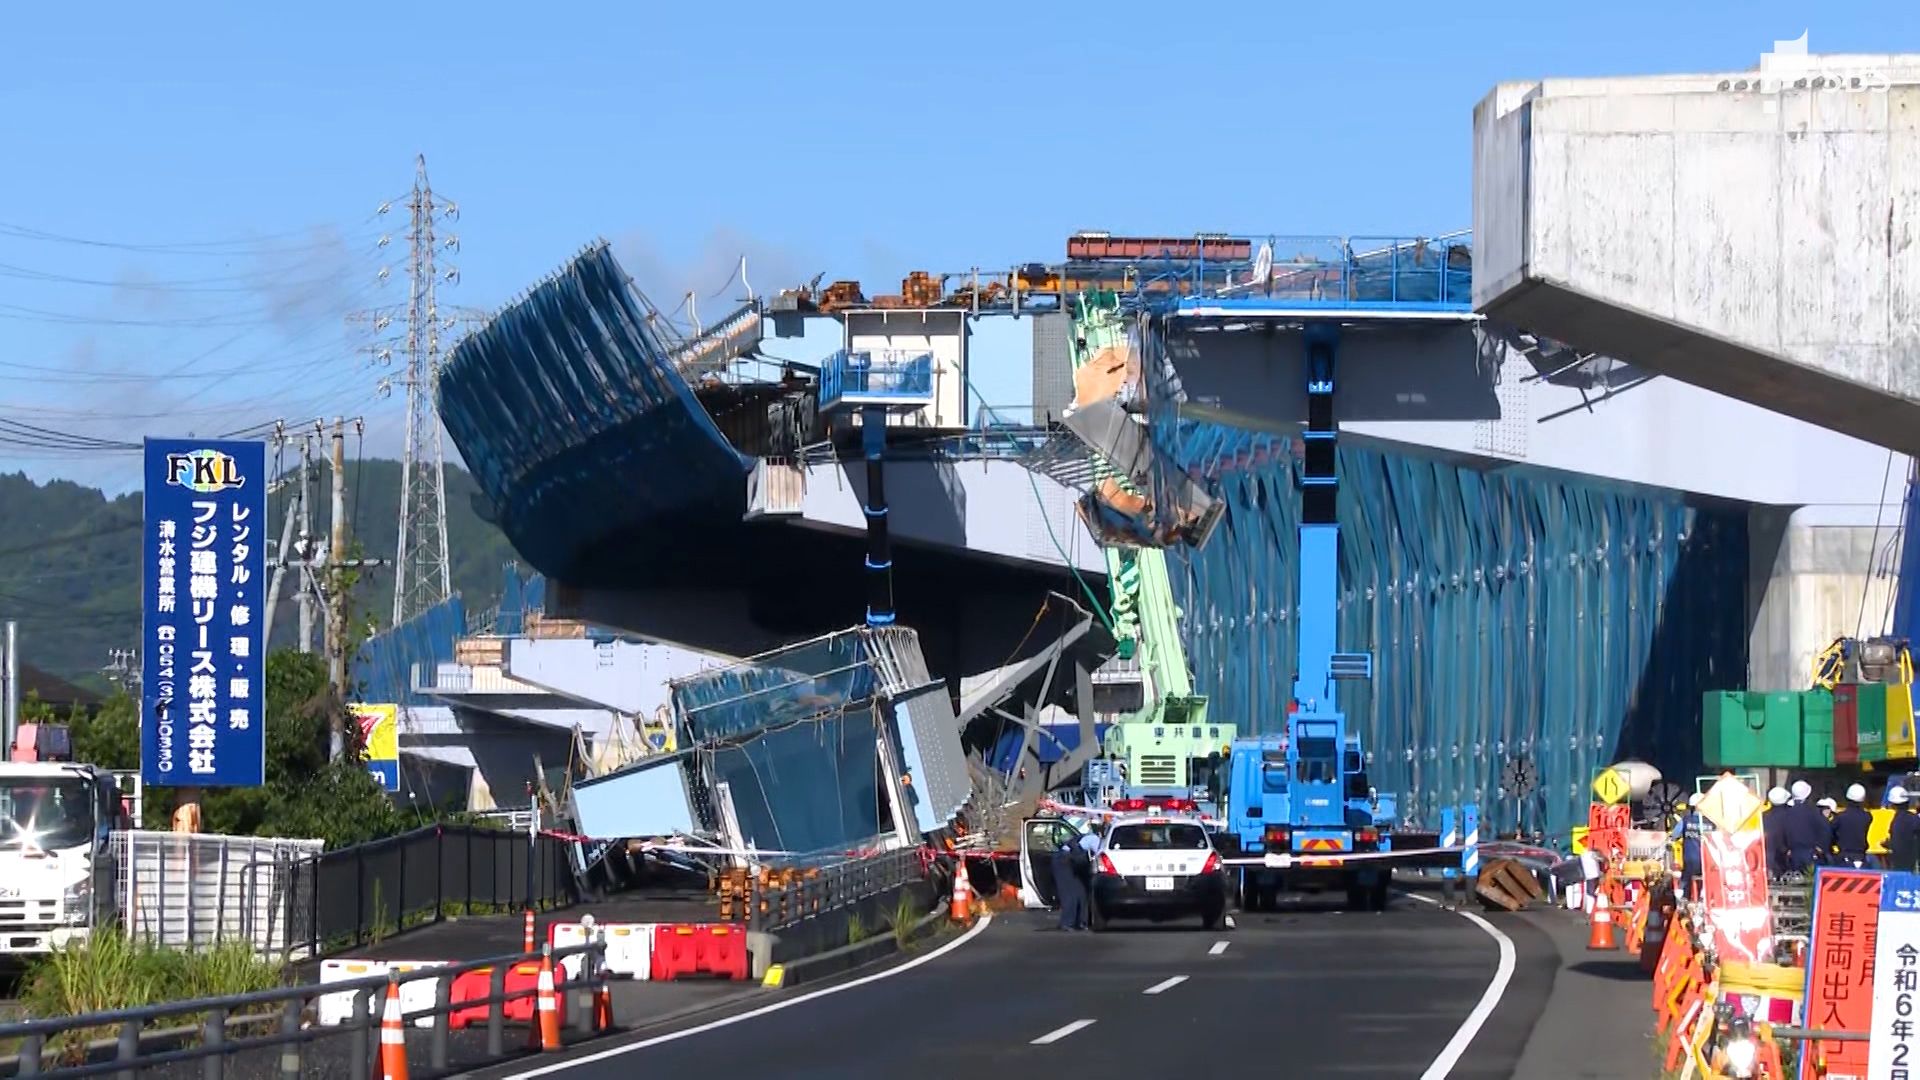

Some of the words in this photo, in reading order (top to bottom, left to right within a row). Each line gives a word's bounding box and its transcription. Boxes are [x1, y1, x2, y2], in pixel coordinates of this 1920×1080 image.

[166, 453, 245, 488] FKL
[157, 519, 177, 613] 清水営業所
[189, 501, 218, 774] フジ建機リース株式会社
